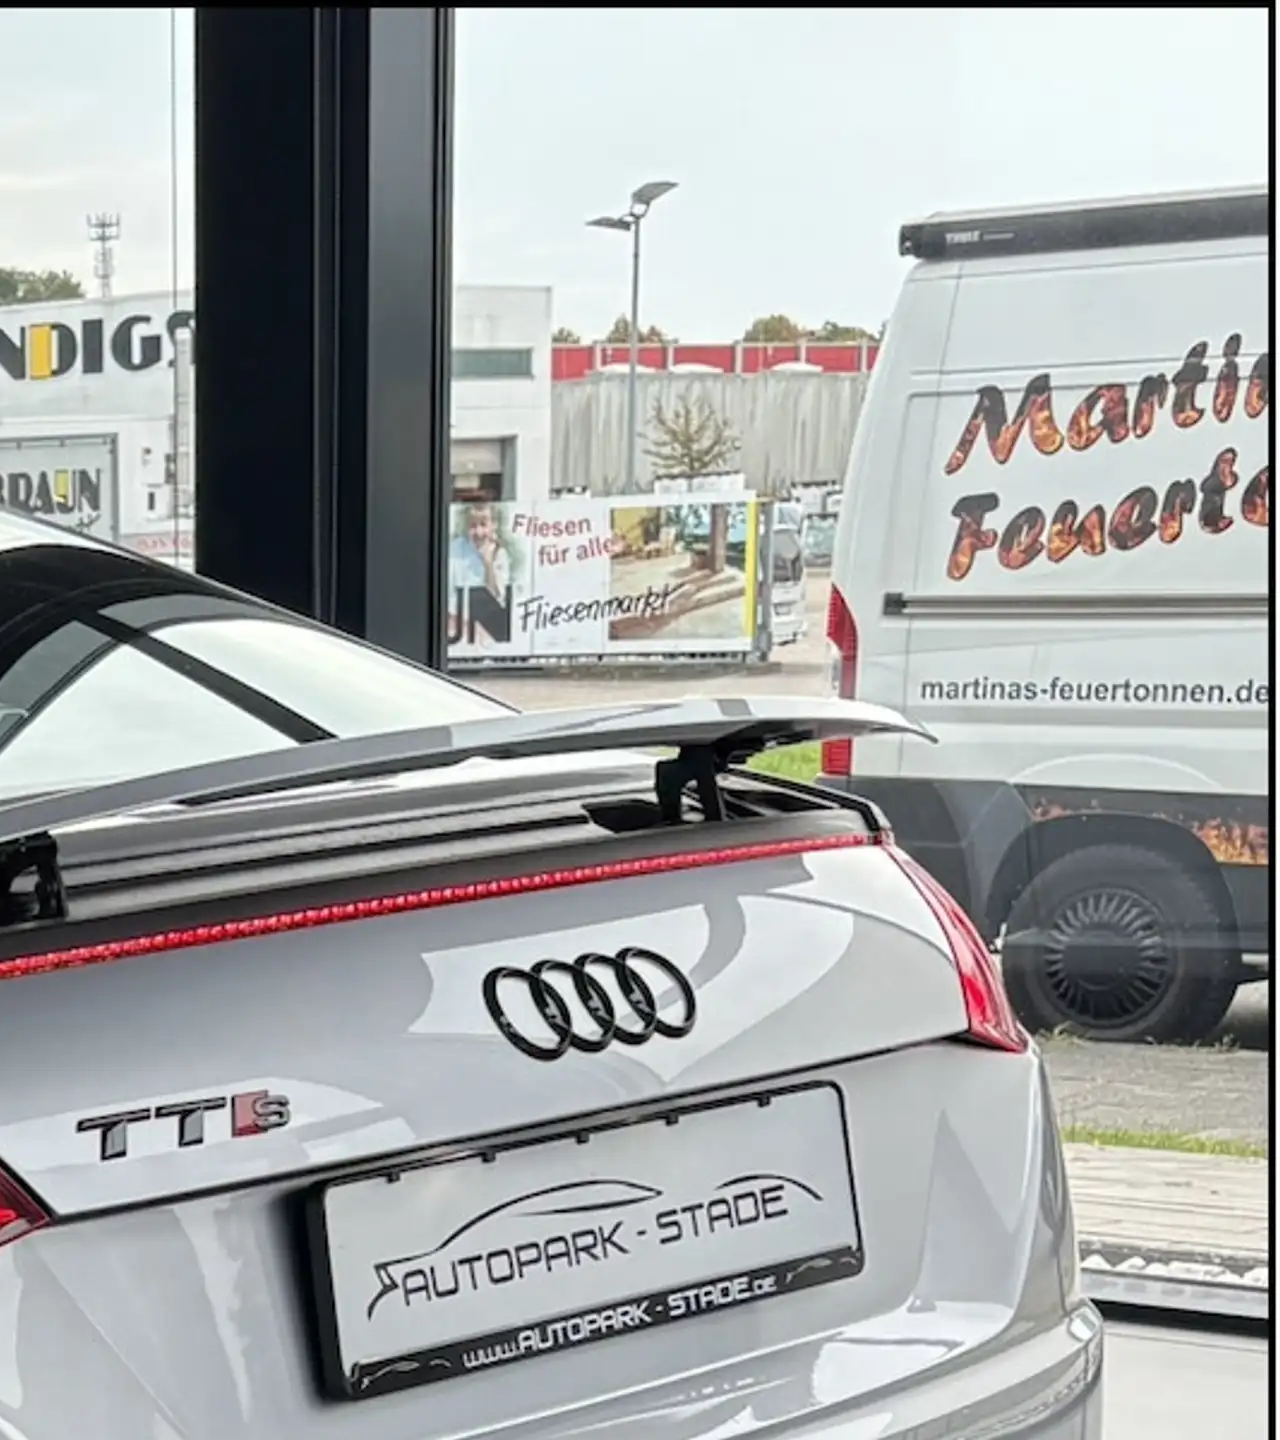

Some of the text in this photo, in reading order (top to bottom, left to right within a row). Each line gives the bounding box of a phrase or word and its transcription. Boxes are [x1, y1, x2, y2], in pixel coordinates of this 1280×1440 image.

[512, 513, 592, 538] Fliesen
[539, 543, 569, 566] für
[517, 582, 685, 633] Fliesenmarkt
[920, 676, 1268, 704] martinas-feuertonnen.de
[401, 1220, 630, 1306] AUTOPARK
[655, 1184, 789, 1246] STADE
